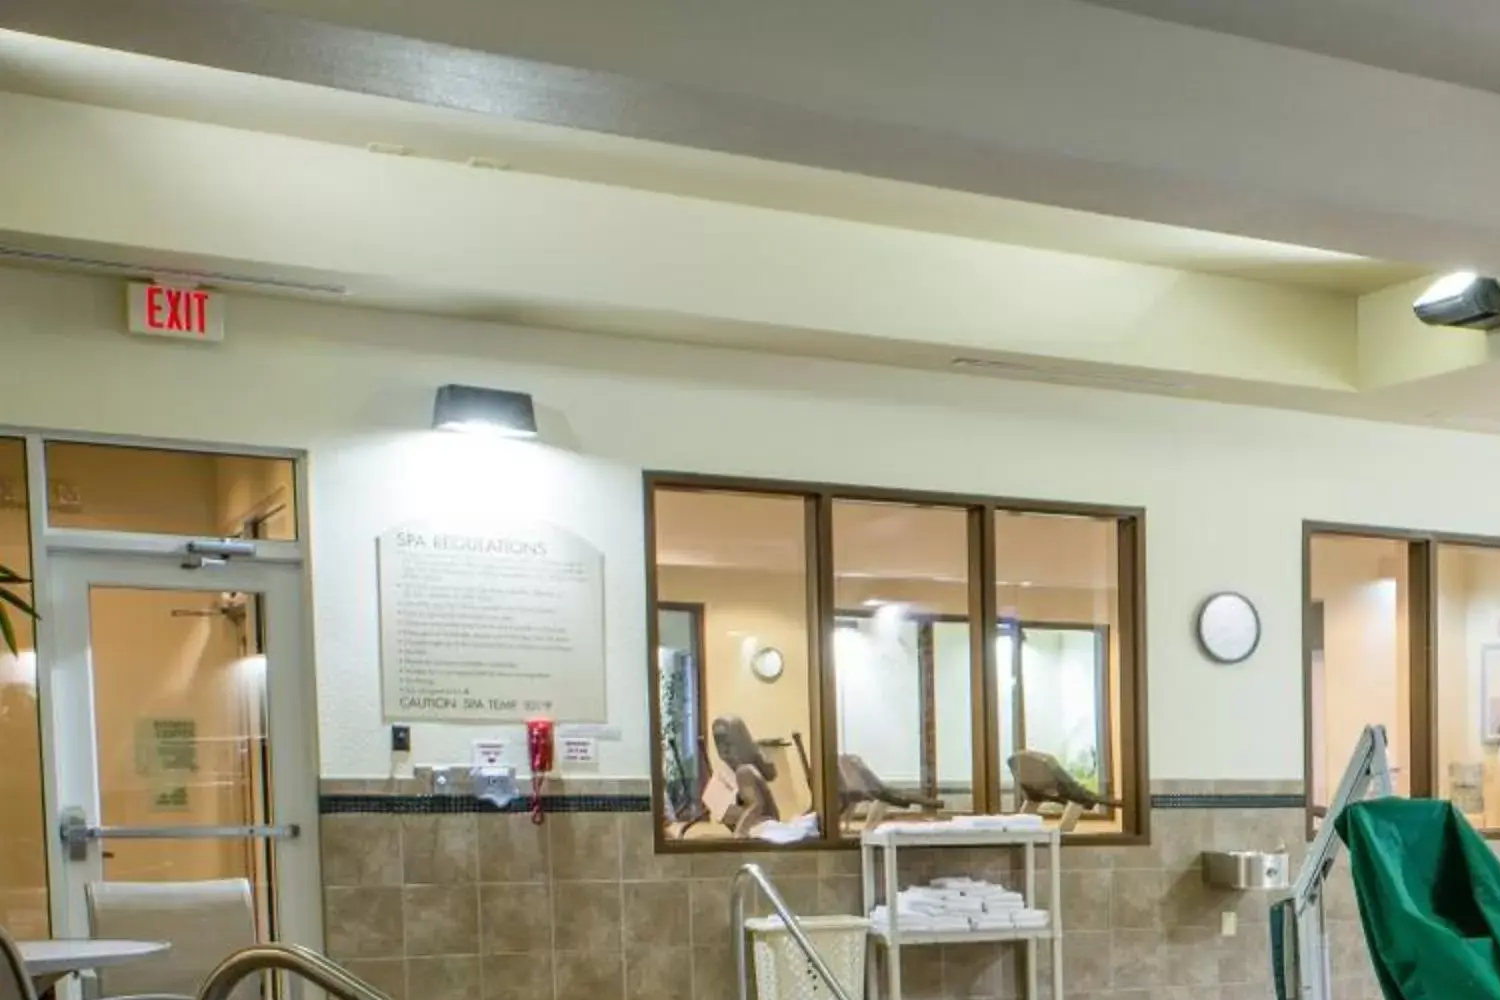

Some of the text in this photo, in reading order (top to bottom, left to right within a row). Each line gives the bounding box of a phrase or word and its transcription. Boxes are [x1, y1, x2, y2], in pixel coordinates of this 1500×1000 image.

[146, 286, 209, 334] EXIT
[397, 532, 427, 548] SPA
[400, 697, 456, 711] CAUTION
[463, 699, 485, 712] SPA
[489, 699, 518, 712] TEMP
